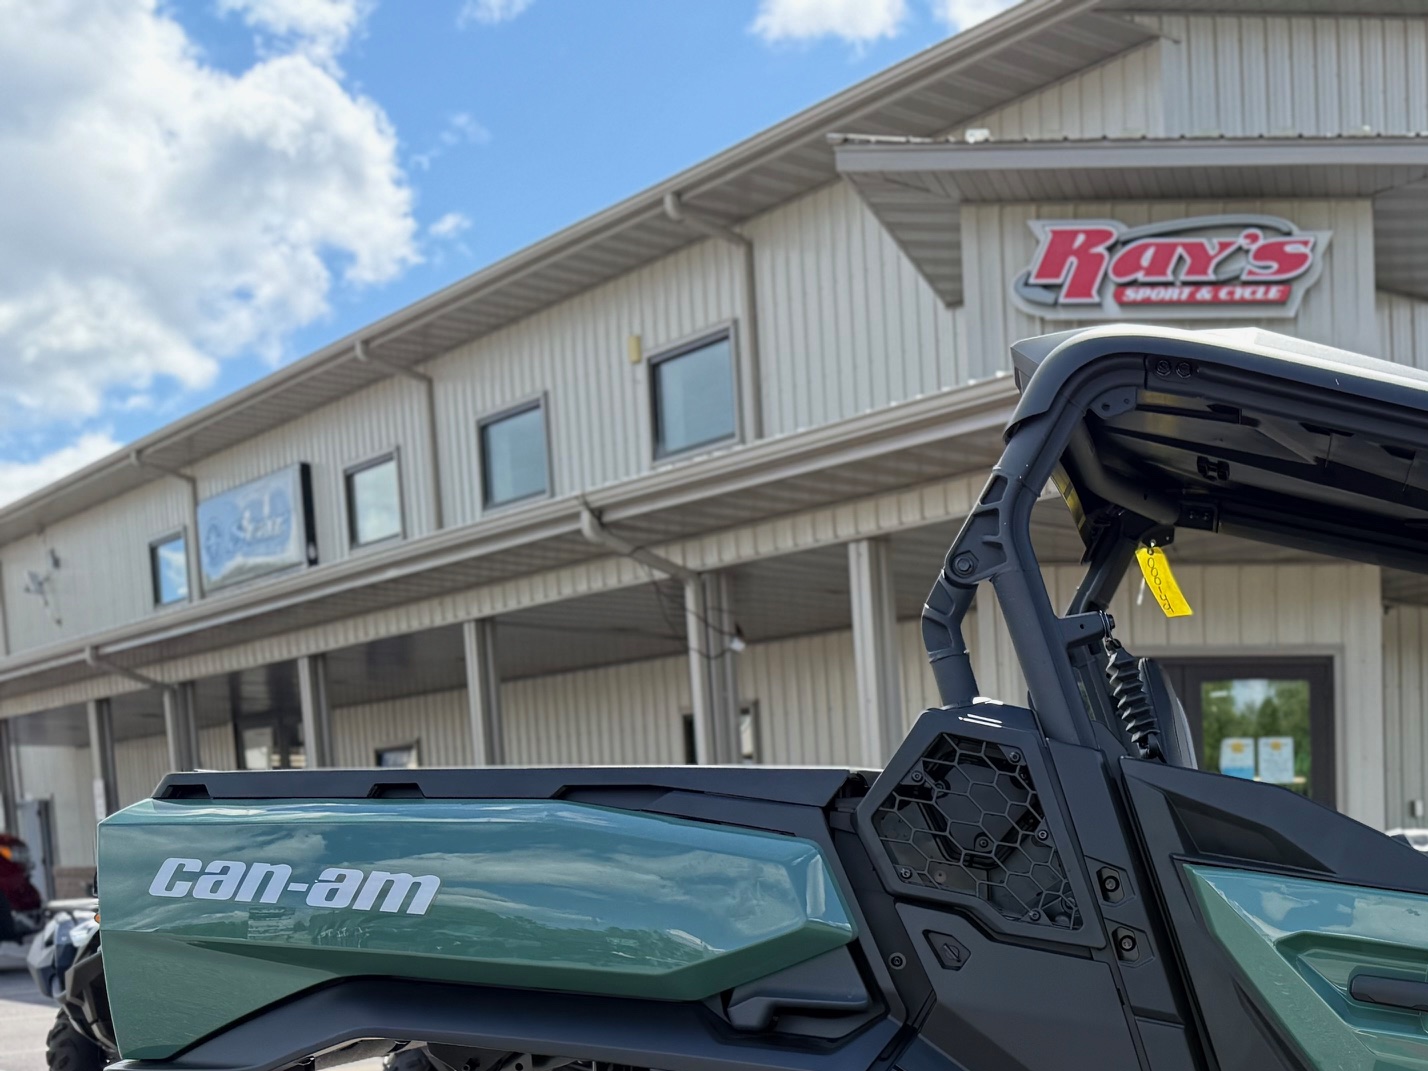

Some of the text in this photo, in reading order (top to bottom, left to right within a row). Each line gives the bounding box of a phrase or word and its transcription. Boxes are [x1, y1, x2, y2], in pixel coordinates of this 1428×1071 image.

[1123, 285, 1283, 301] SPORT & CYCLE
[149, 857, 441, 915] can-am
